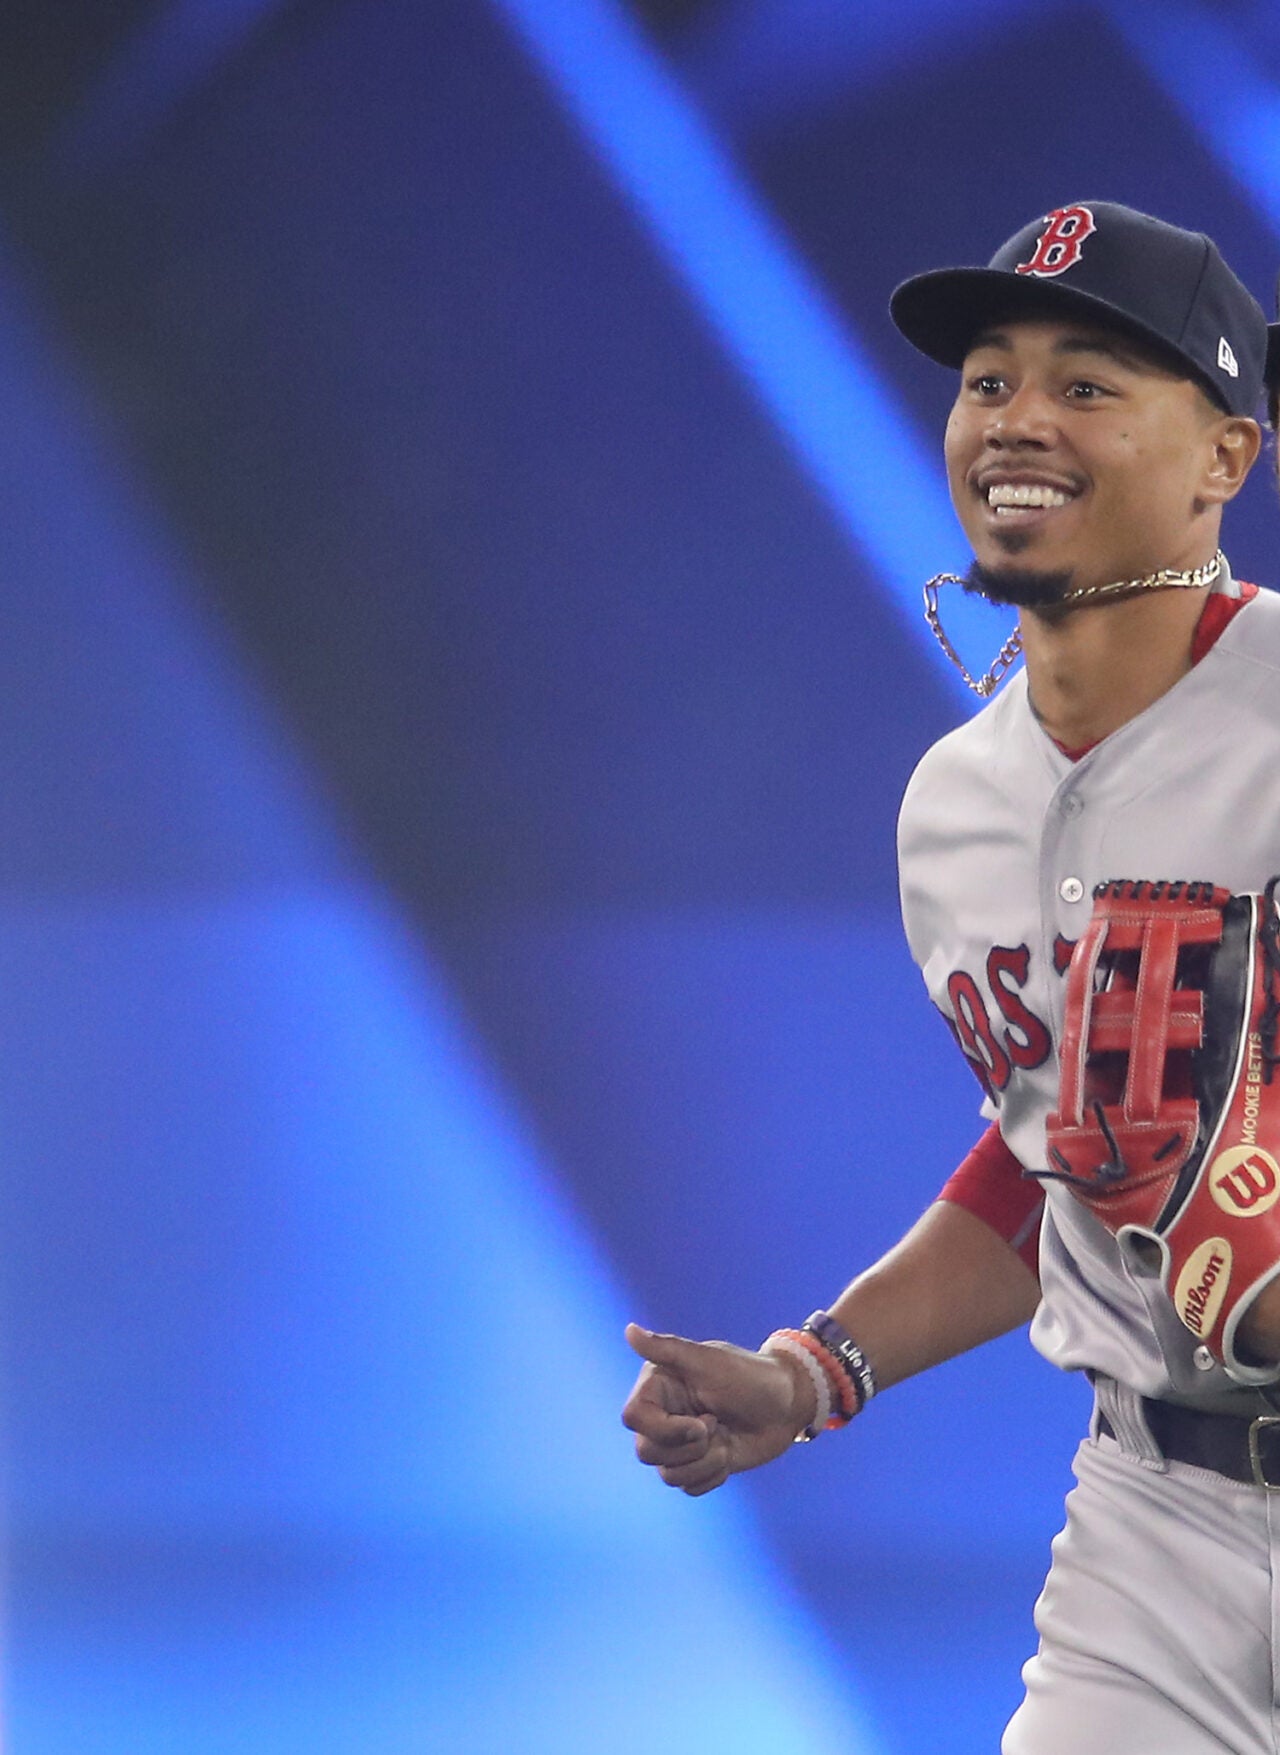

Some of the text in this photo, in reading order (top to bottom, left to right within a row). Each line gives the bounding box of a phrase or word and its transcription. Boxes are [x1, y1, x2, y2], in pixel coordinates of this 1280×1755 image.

[1014, 206, 1098, 278] B
[1240, 1031, 1263, 1144] MOOKIE BETTS
[1215, 1153, 1277, 1209] W
[1184, 1253, 1226, 1334] Wilson
[839, 1339, 863, 1368] Life
